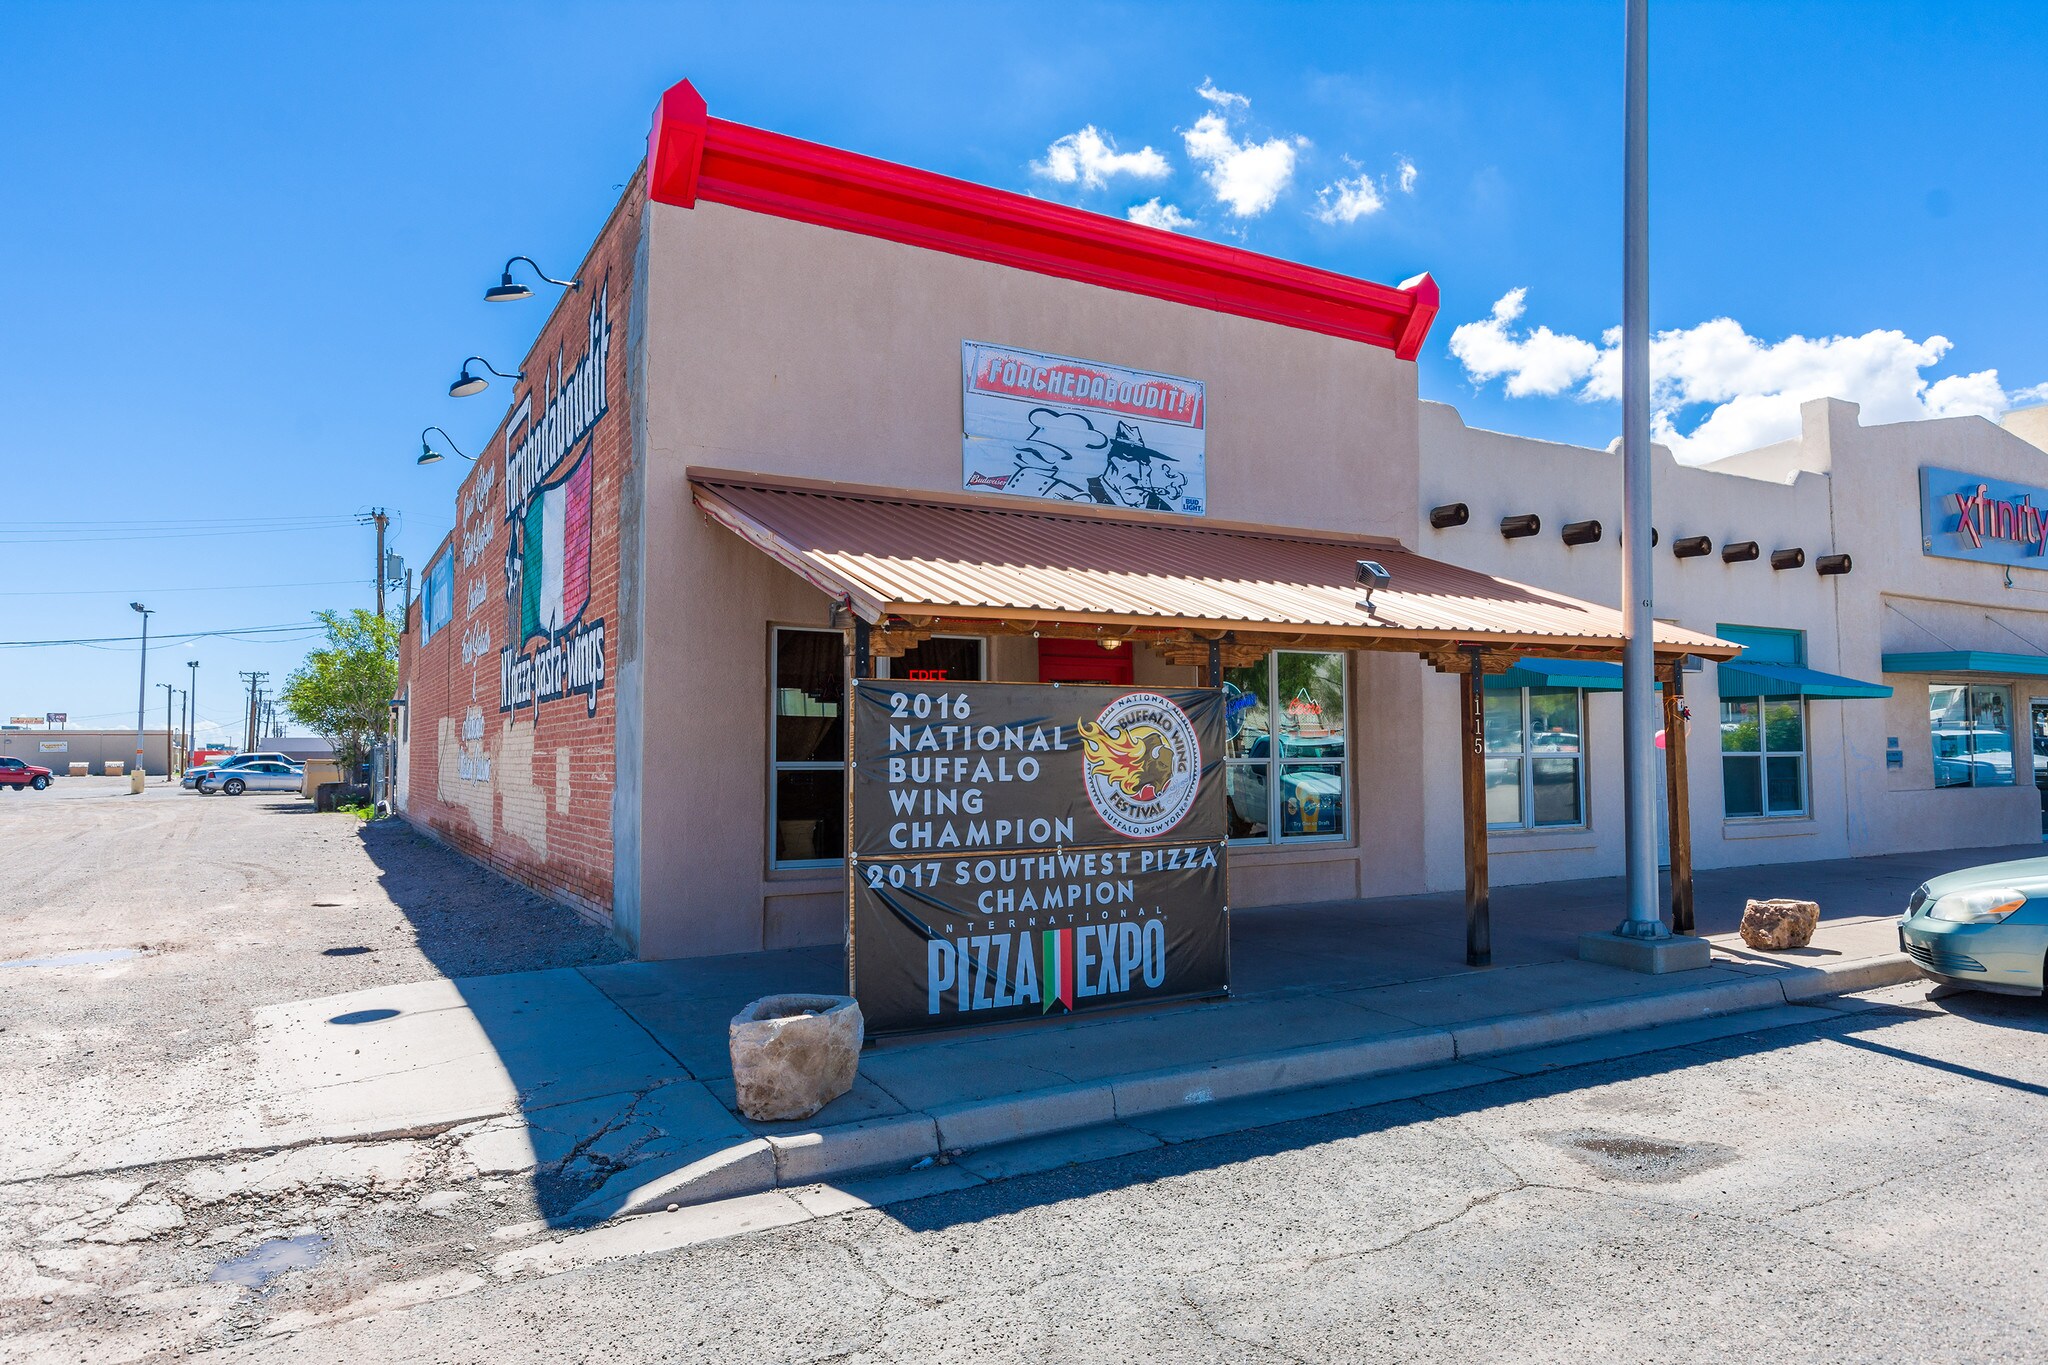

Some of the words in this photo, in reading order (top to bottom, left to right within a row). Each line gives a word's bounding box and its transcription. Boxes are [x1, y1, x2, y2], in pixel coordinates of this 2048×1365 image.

[987, 359, 1187, 414] FORGHEDABOUDIT!
[970, 474, 1006, 486] Budweiser
[1182, 503, 1202, 512] LIGHT
[1185, 498, 1200, 506] BUD
[1954, 483, 2048, 557] xfinity
[500, 648, 513, 708] NY
[534, 622, 562, 721] pasta
[566, 620, 605, 711] wings
[889, 692, 971, 720] 2016
[1117, 694, 1170, 708] NATIONAL
[889, 723, 1069, 752] NATIONAL
[1117, 709, 1174, 732] BUFFALO
[1171, 728, 1188, 773] WING
[1474, 699, 1483, 754] 115
[889, 756, 1041, 784] BUFFALO
[888, 788, 984, 817] WING
[1110, 791, 1166, 819] FESTIVAL
[888, 816, 1075, 849] CHAMPION
[1144, 823, 1164, 834] NEW
[866, 862, 941, 889] 2017
[955, 851, 1131, 885] SOUTHWEST
[1141, 846, 1218, 873] PIZZA
[977, 879, 1134, 914] CHAMPION
[928, 905, 1162, 935] INTERNATIONAL
[927, 930, 1041, 1016] PIZZA
[1076, 918, 1166, 998] EXPO
